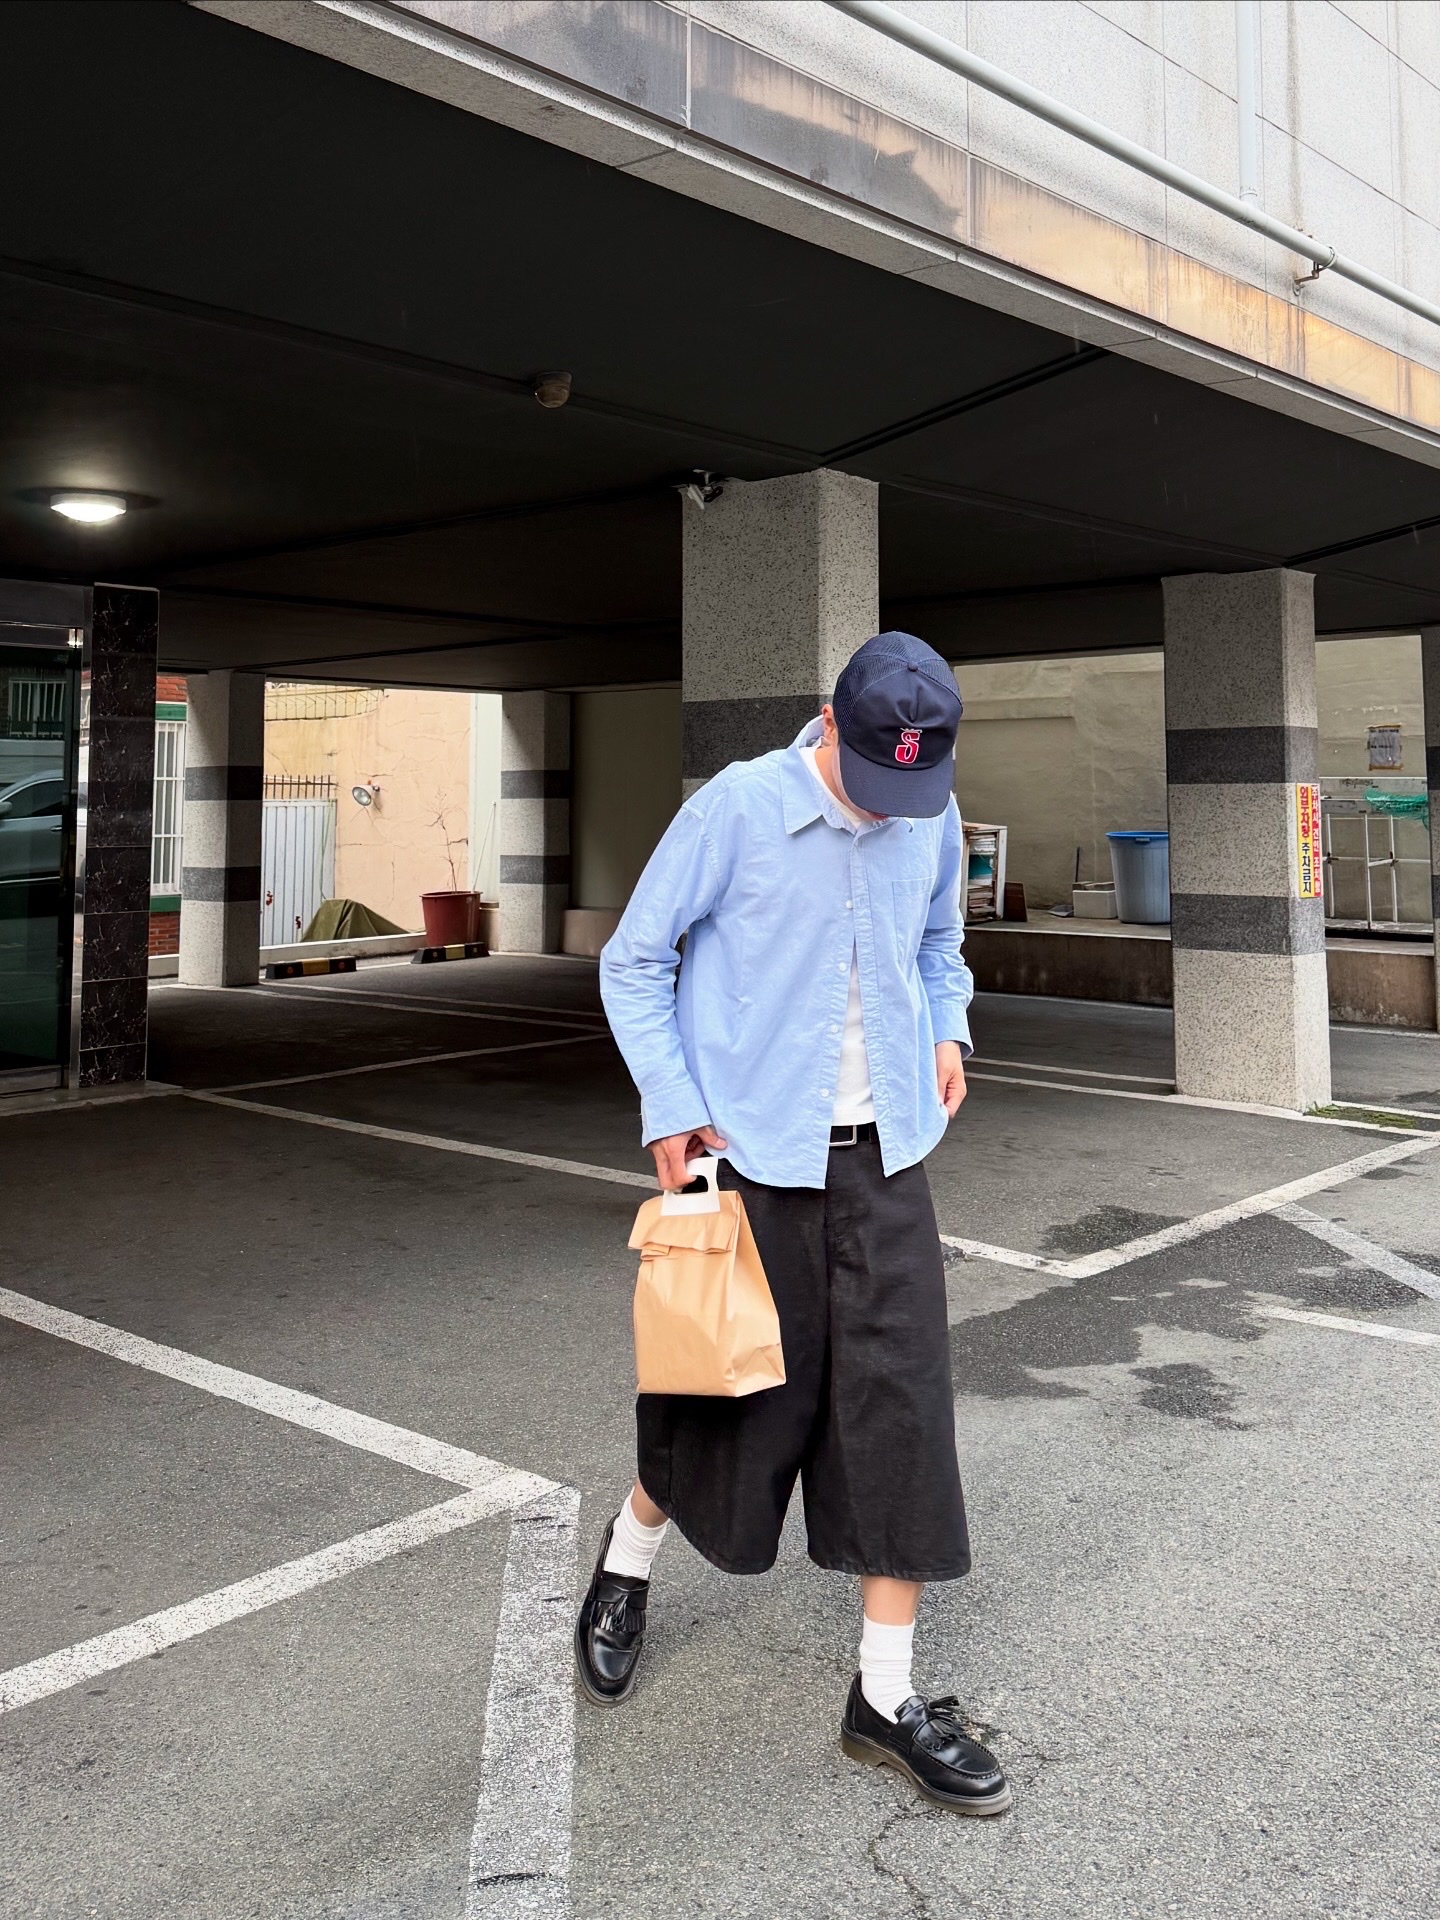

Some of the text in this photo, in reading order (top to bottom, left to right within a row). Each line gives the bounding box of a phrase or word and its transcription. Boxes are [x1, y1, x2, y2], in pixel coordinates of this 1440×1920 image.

[895, 731, 920, 764] S
[1300, 786, 1311, 893] 외부차량 주차금지
